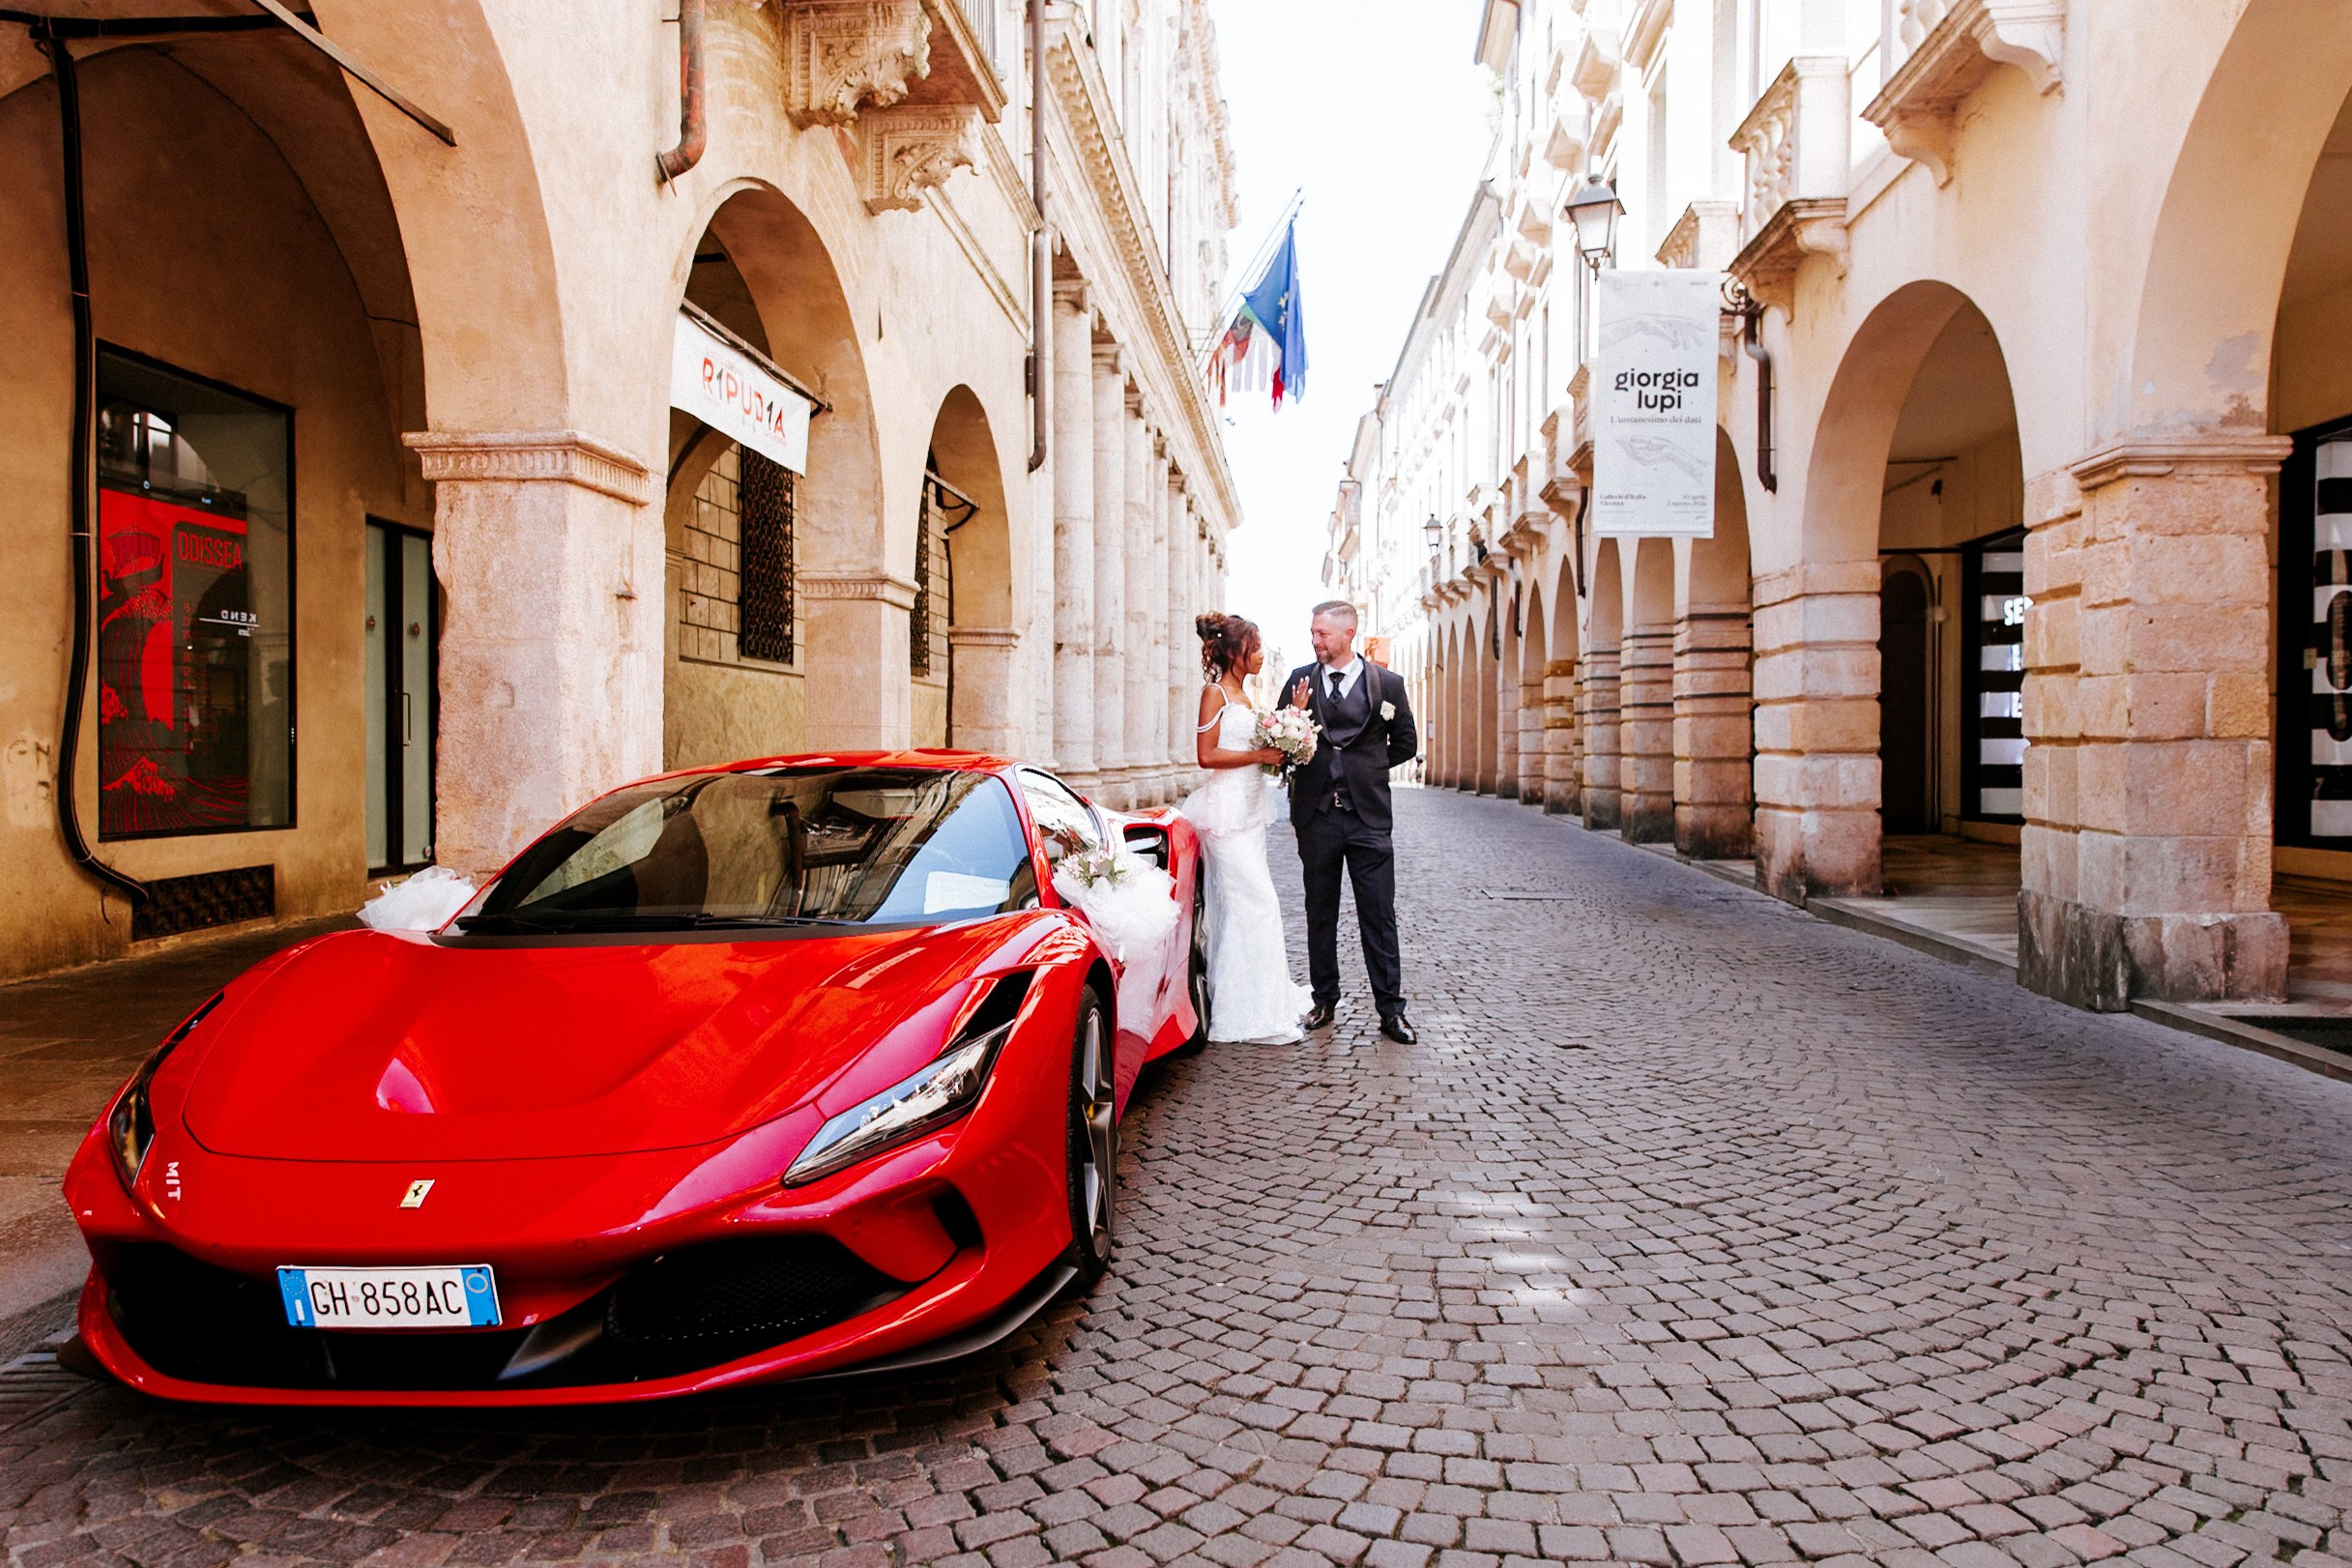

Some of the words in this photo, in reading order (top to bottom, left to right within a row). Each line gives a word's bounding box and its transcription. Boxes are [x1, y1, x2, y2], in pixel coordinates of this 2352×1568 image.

[1614, 368, 1699, 392] giorgia
[1638, 390, 1682, 414] lupi
[1684, 415, 1701, 423] dati
[177, 531, 243, 570] ODISSEA
[165, 1161, 182, 1202] MIT
[310, 1281, 351, 1316] GH
[361, 1280, 463, 1316] 858AC
